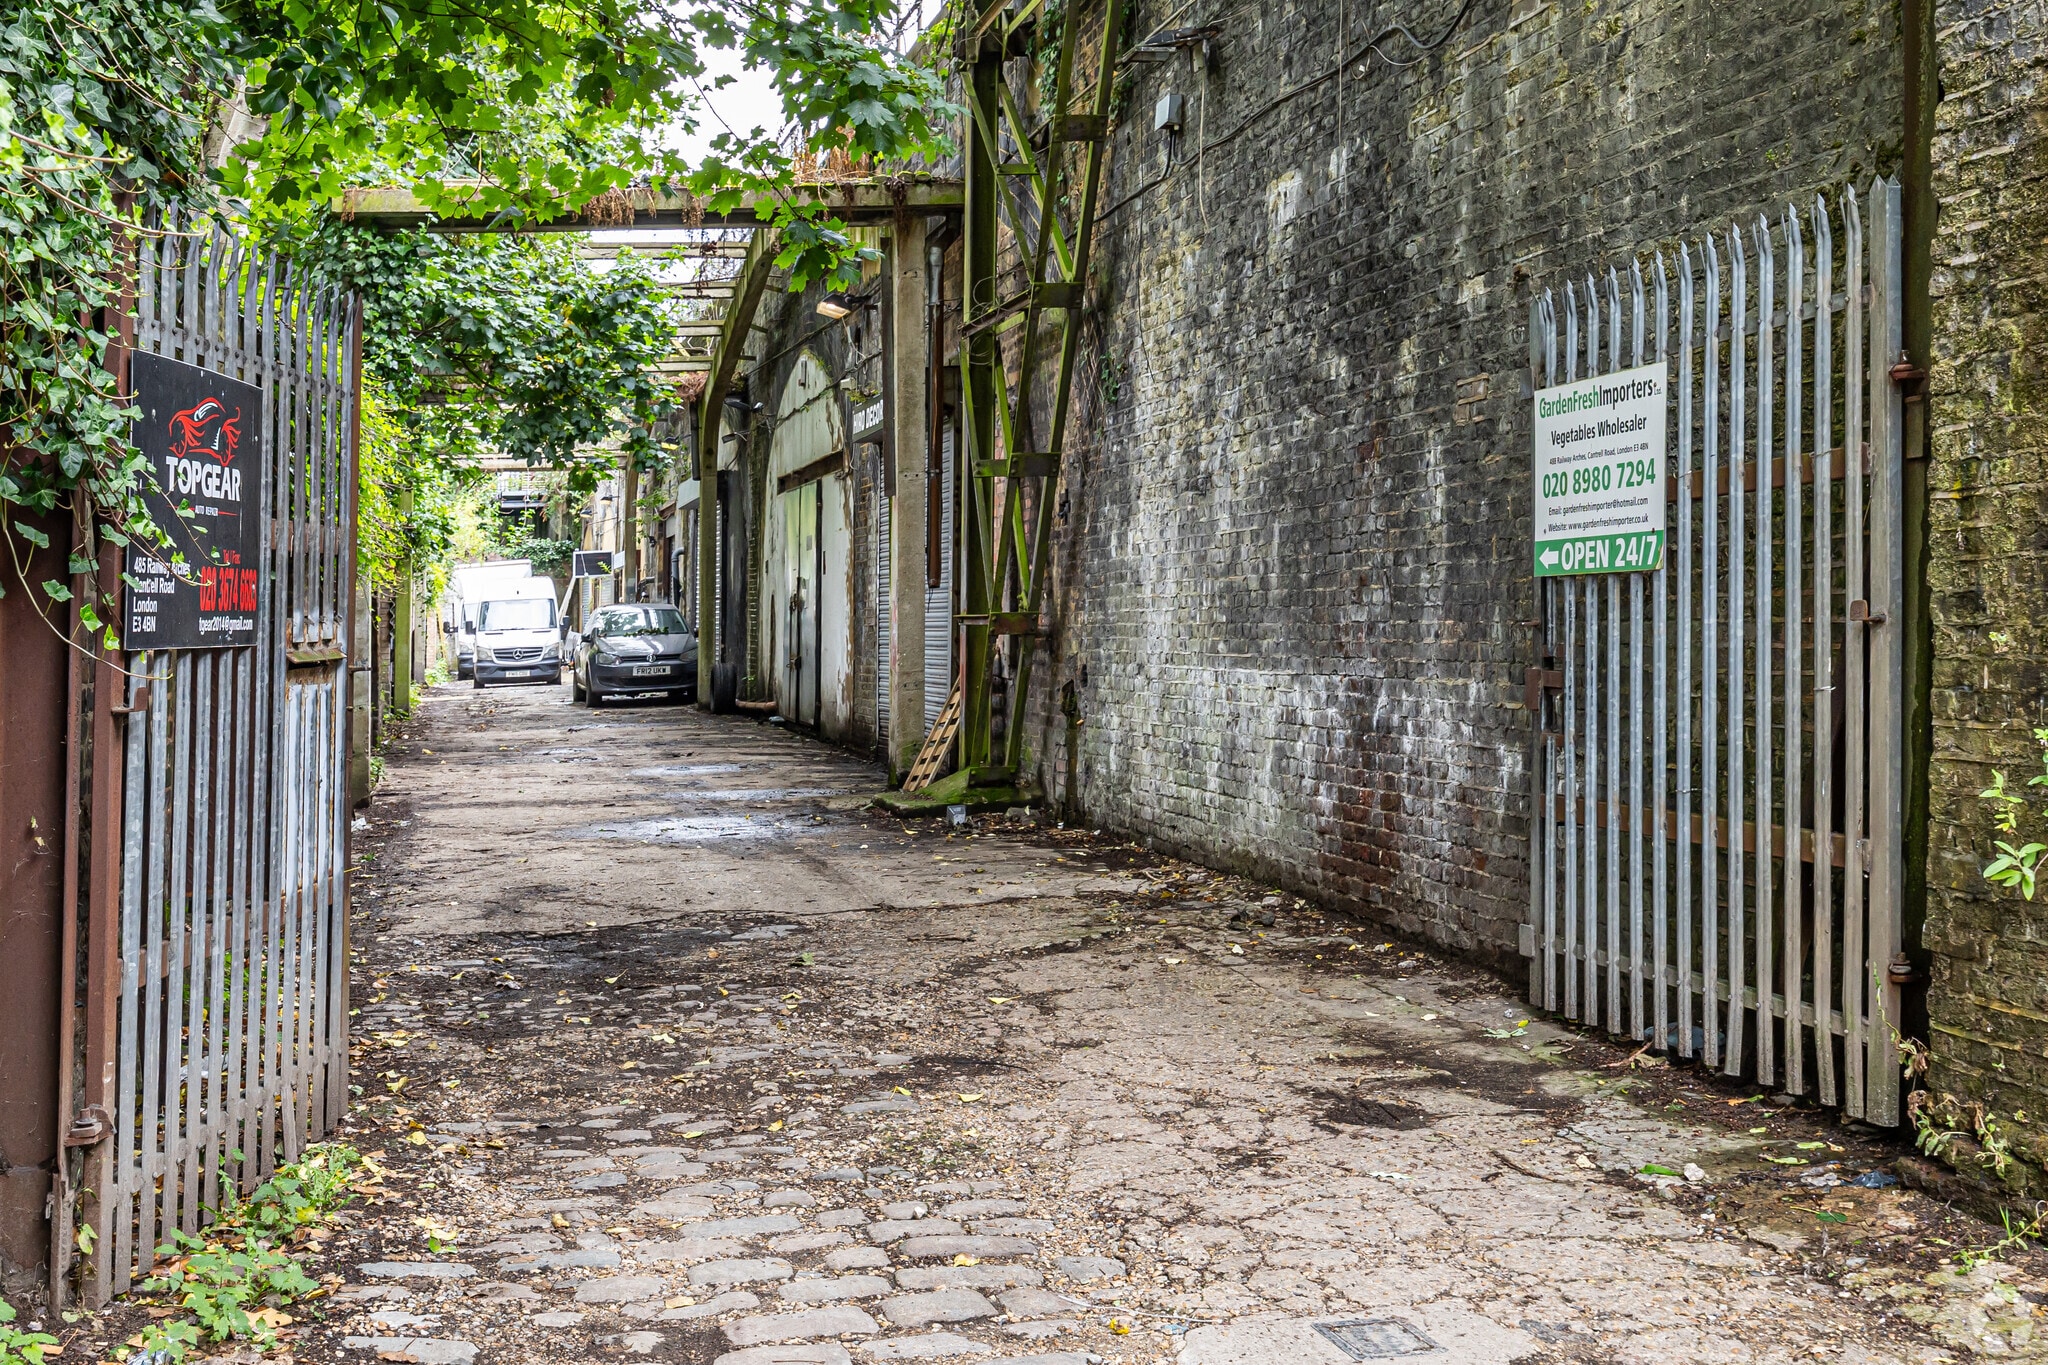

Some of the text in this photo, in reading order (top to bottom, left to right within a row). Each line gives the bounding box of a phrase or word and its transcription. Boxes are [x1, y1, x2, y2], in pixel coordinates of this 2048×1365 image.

[1551, 414, 1648, 449] Vegetables Wholesaler
[1557, 454, 1573, 464] Railway
[1617, 444, 1634, 455] London
[1634, 443, 1640, 452] E3
[166, 456, 241, 502] TOPGEAR
[1543, 457, 1656, 499] 020 8980 7294
[1561, 535, 1657, 571] OPEN 24/7
[160, 577, 175, 594] Road
[200, 566, 217, 612] 020
[218, 567, 238, 612] 3674
[133, 597, 158, 613] London
[132, 616, 156, 633] E3 4BN
